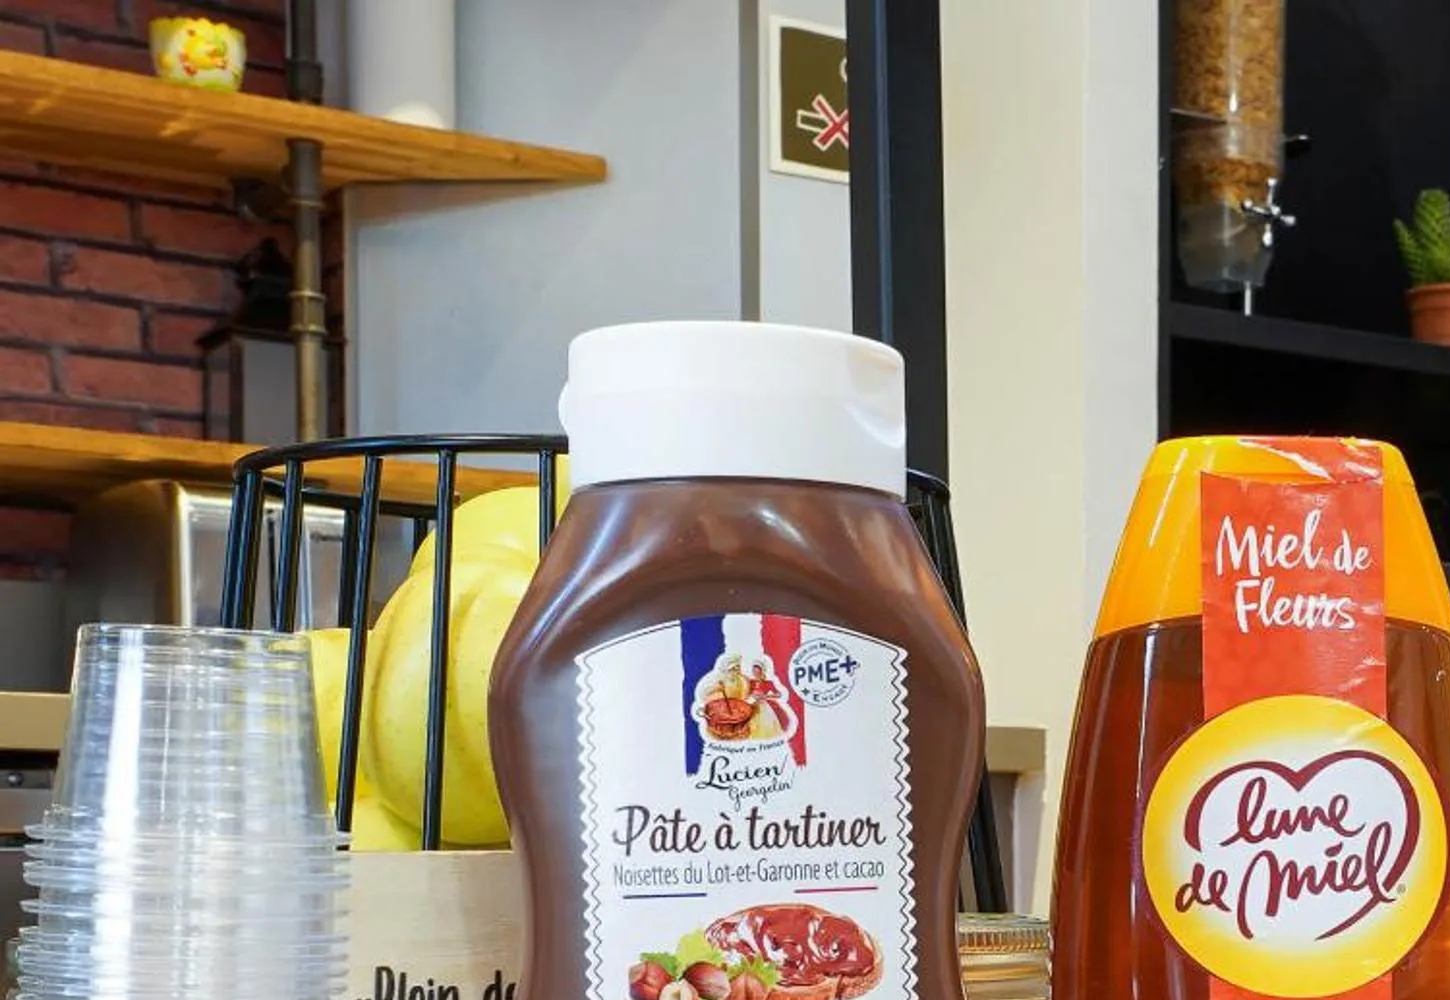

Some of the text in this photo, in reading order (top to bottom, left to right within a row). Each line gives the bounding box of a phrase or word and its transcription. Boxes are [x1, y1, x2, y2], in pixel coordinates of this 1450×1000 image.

[1215, 509, 1371, 577] Miel de
[1234, 576, 1356, 634] Fleurs
[794, 654, 857, 687] PME+
[695, 754, 789, 790] Lucien
[728, 774, 796, 812] Georgelin
[612, 804, 887, 857] Pâte à tartiner
[1219, 775, 1367, 848] lune
[613, 857, 885, 887] Noisettes du Lot-et-Garonne et cacao
[1174, 863, 1232, 913] de
